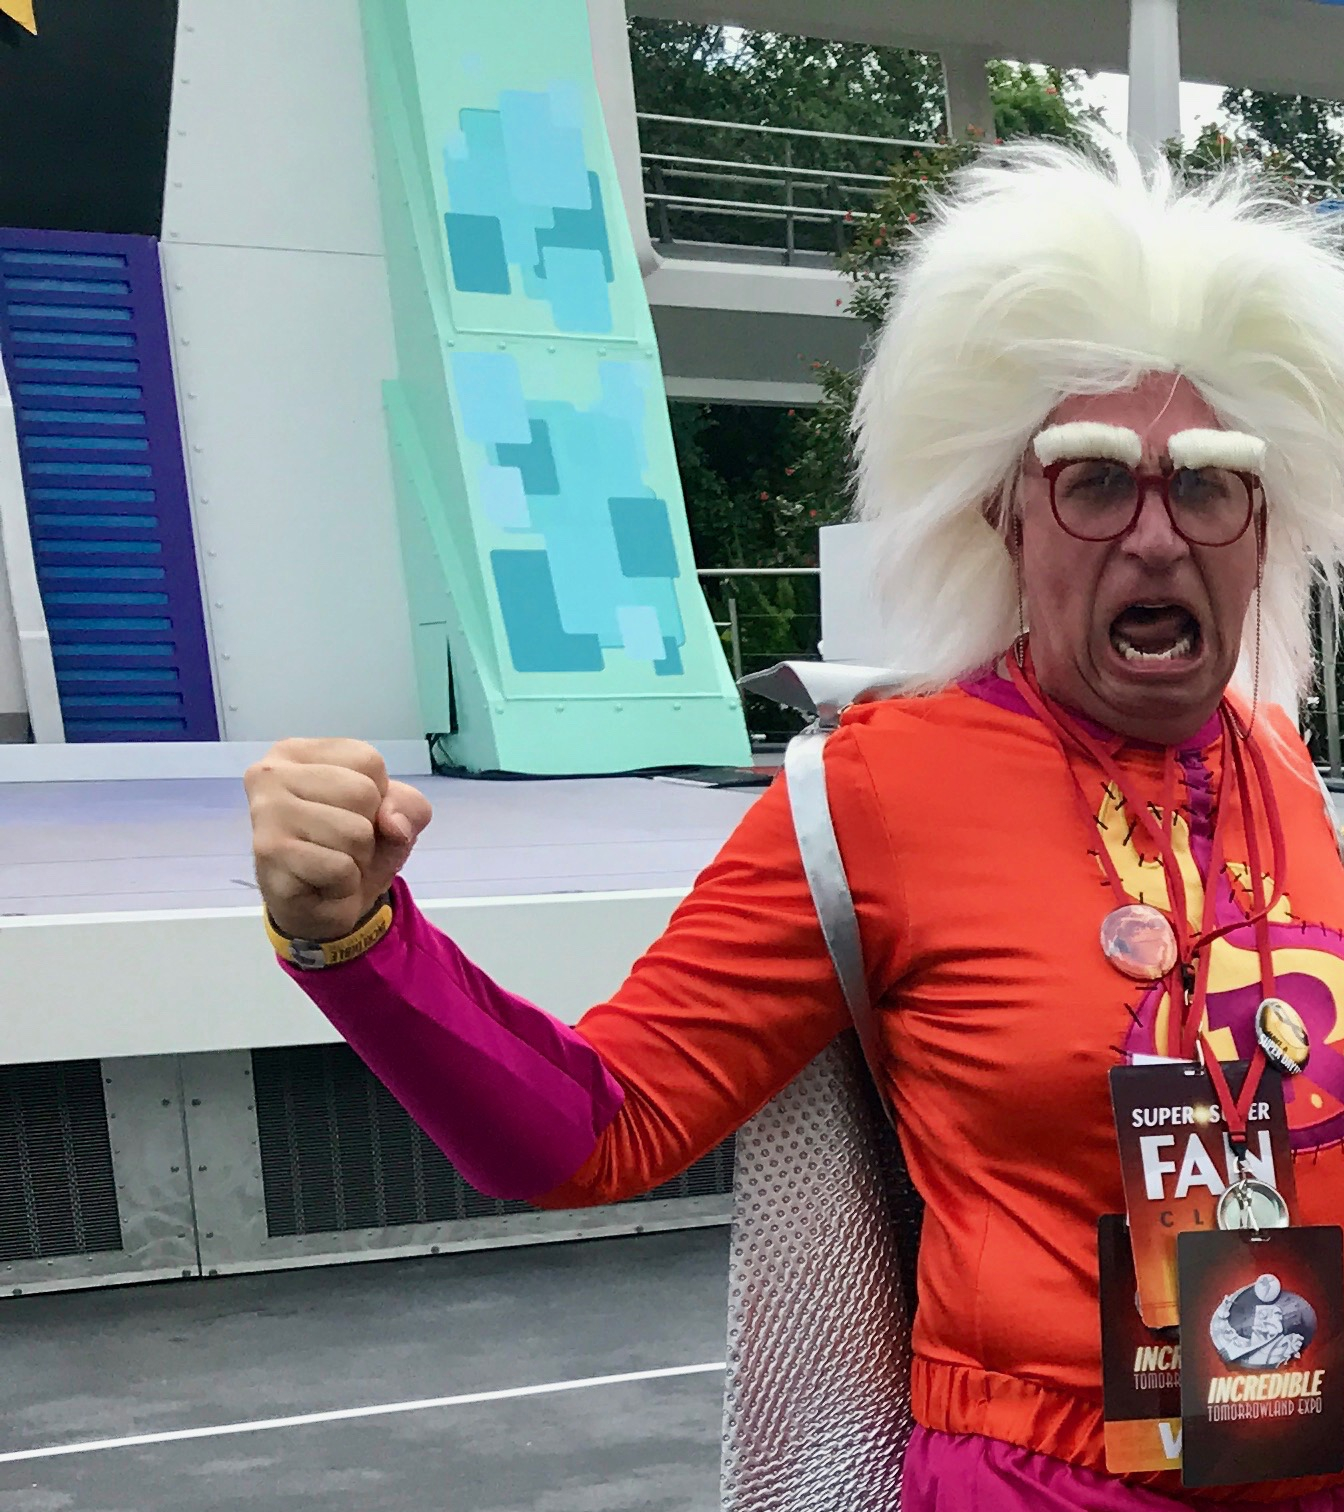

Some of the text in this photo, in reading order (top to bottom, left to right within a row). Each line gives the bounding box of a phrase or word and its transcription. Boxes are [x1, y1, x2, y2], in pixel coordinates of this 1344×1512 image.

[1258, 1033, 1282, 1060] SUPER
[1131, 1102, 1271, 1128] SUPER SER
[1139, 1130, 1277, 1201] FAN
[1159, 1208, 1205, 1228] CL
[1207, 1369, 1326, 1404] INCREDIBLE
[1207, 1396, 1323, 1423] TOMORROWLAND EXPO
